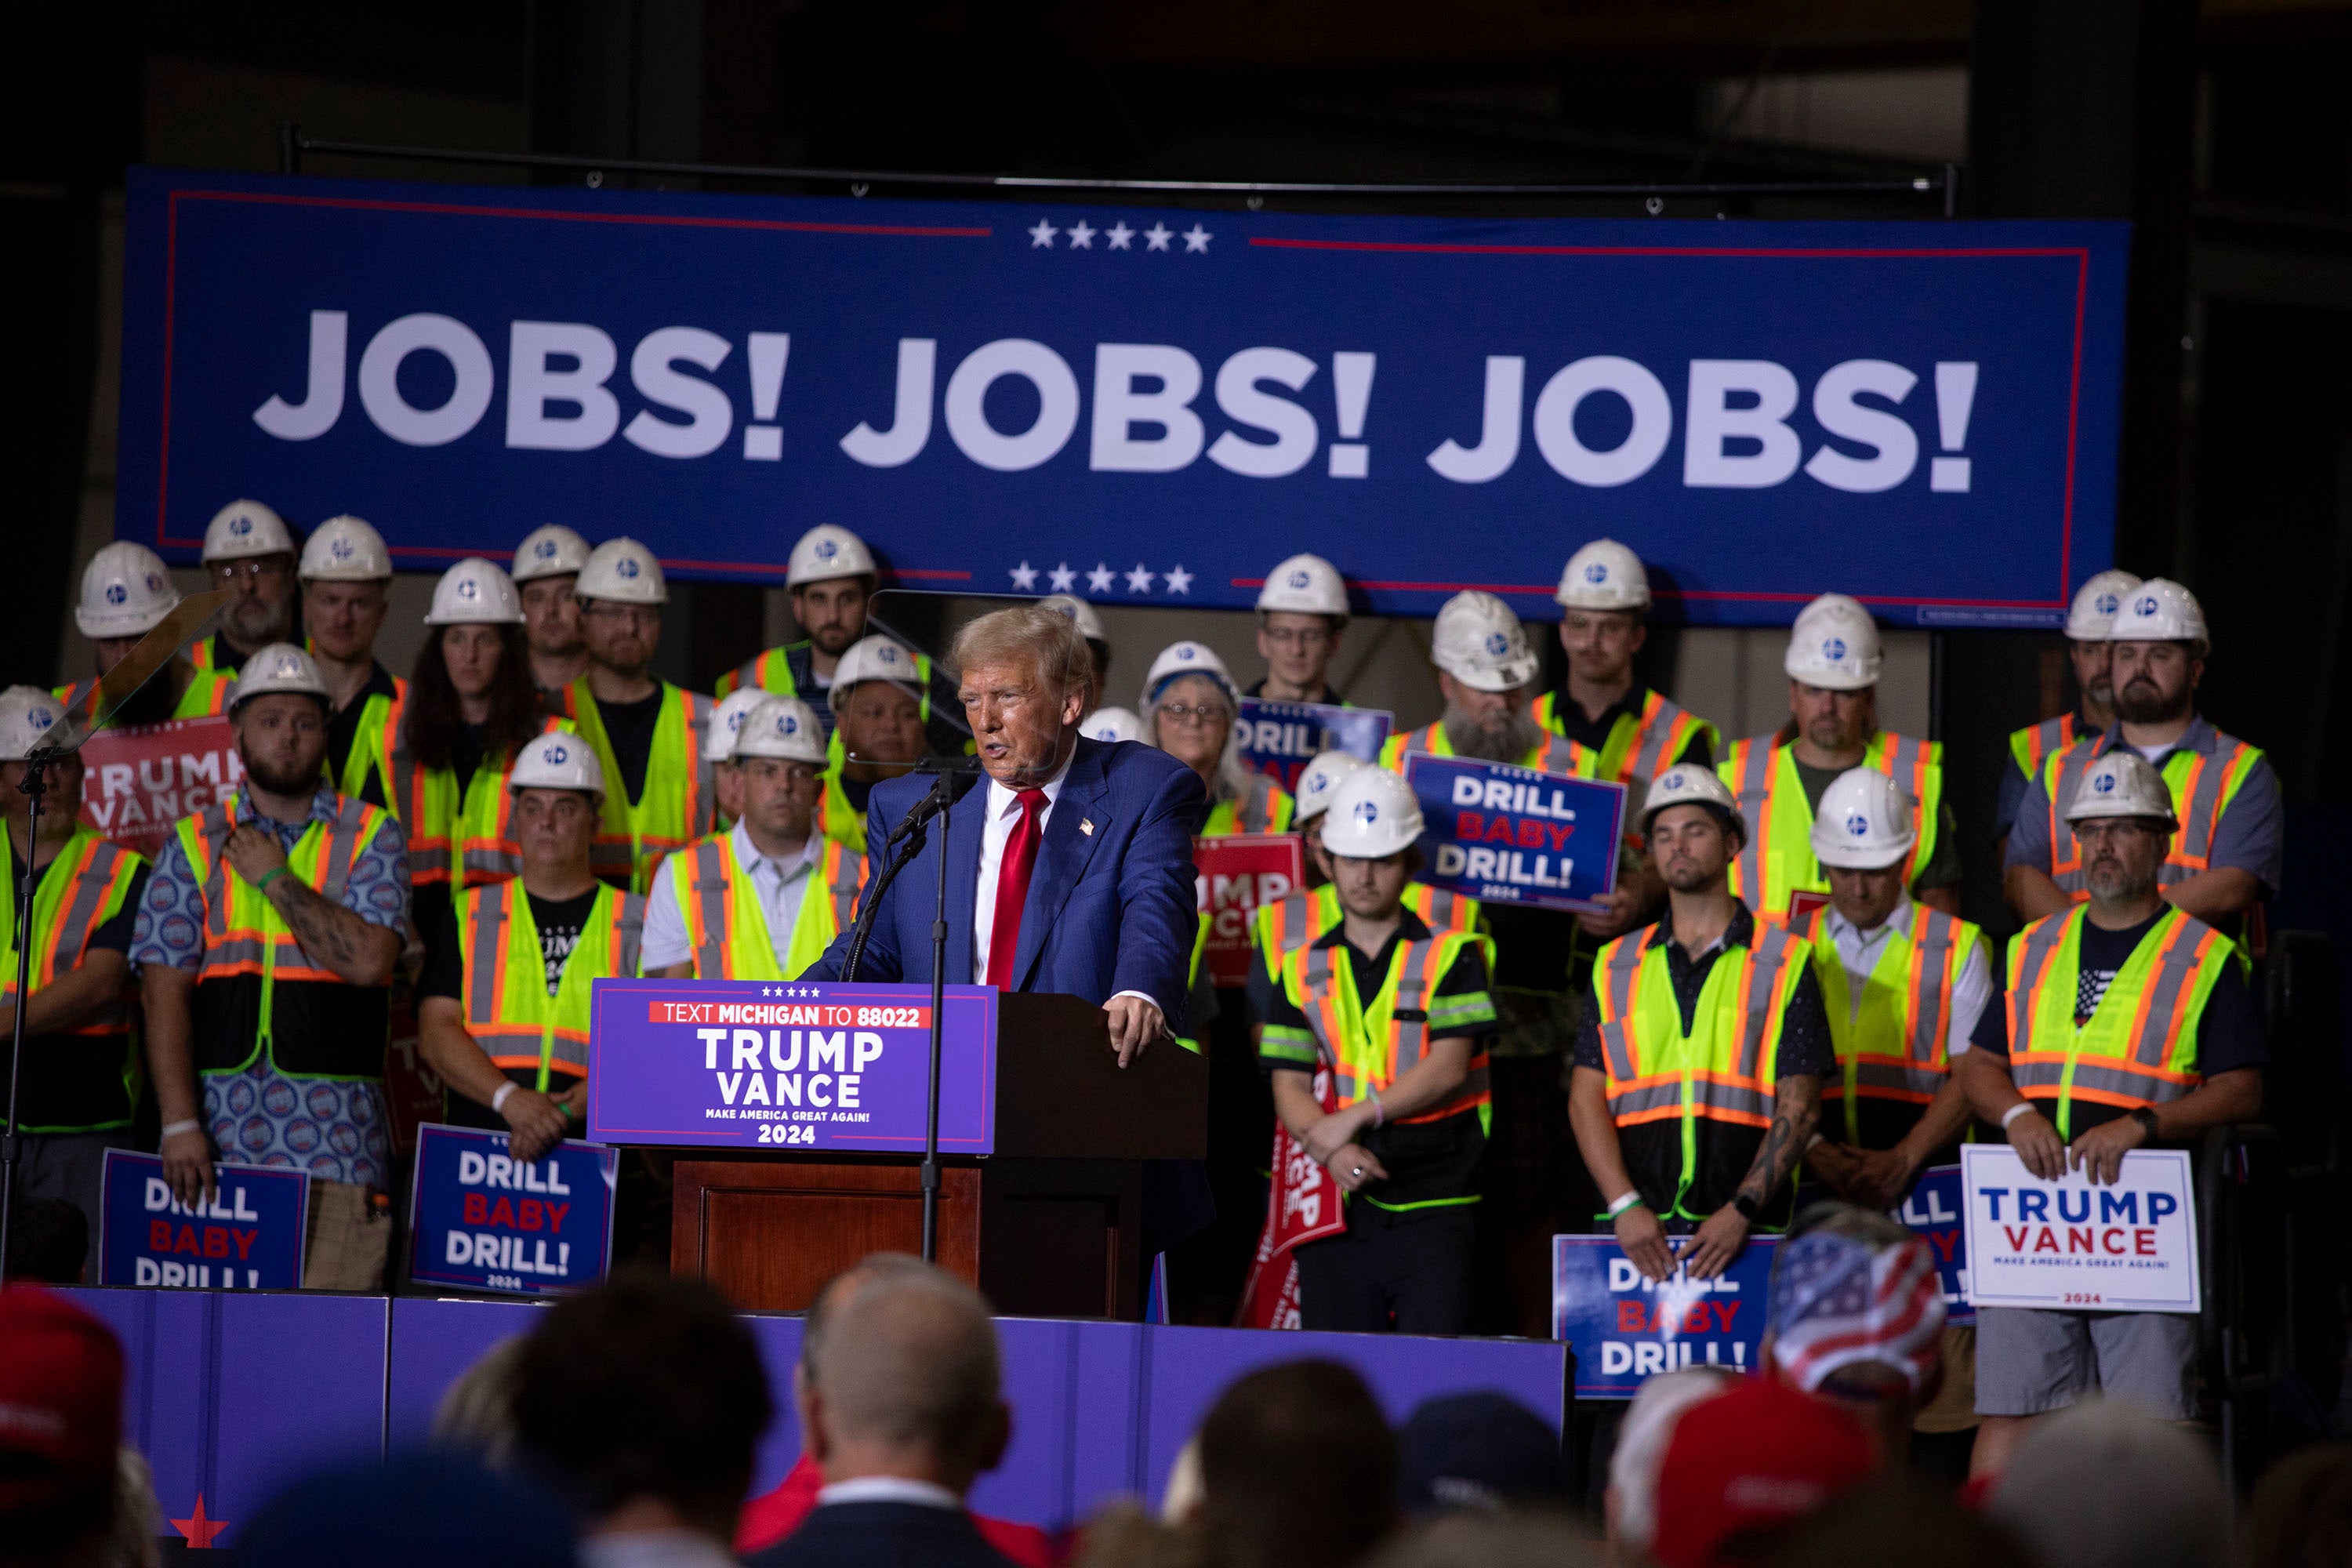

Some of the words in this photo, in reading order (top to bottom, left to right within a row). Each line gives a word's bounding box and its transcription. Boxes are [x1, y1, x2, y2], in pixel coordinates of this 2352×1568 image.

[252, 309, 791, 461] JOBS!
[839, 337, 1377, 479] JOBS!
[1425, 354, 1980, 493] JOBS!
[1452, 774, 1576, 821] DRILL
[1455, 811, 1575, 851] BABY
[1435, 843, 1574, 889] DRILL!
[664, 1003, 714, 1022] TEXT
[719, 1004, 819, 1025] MICHIGAN
[825, 1007, 852, 1025] TO
[857, 1008, 920, 1028] 88022
[696, 1028, 884, 1073] TRUMP
[716, 1071, 861, 1108] VANCE
[706, 1109, 737, 1120] MAKE
[739, 1109, 789, 1121] AMERICA
[792, 1111, 828, 1122] GREAT
[830, 1112, 870, 1123] AGAIN!
[757, 1123, 816, 1145] 2024
[458, 1150, 571, 1196] DRILL
[463, 1192, 571, 1234] BABY
[1979, 1188, 2177, 1225] TRUMP
[149, 1218, 259, 1260] BABY
[445, 1229, 571, 1277] DRILL!
[2004, 1225, 2158, 1255] VANCE
[1994, 1256, 2025, 1267] MAKE
[2030, 1257, 2082, 1268] AMERICA
[2086, 1258, 2123, 1269] GREAT
[2128, 1260, 2170, 1269] AGAIN!
[487, 1274, 523, 1291] 2024
[2063, 1293, 2102, 1305] 2024
[1617, 1301, 1742, 1333] BABY
